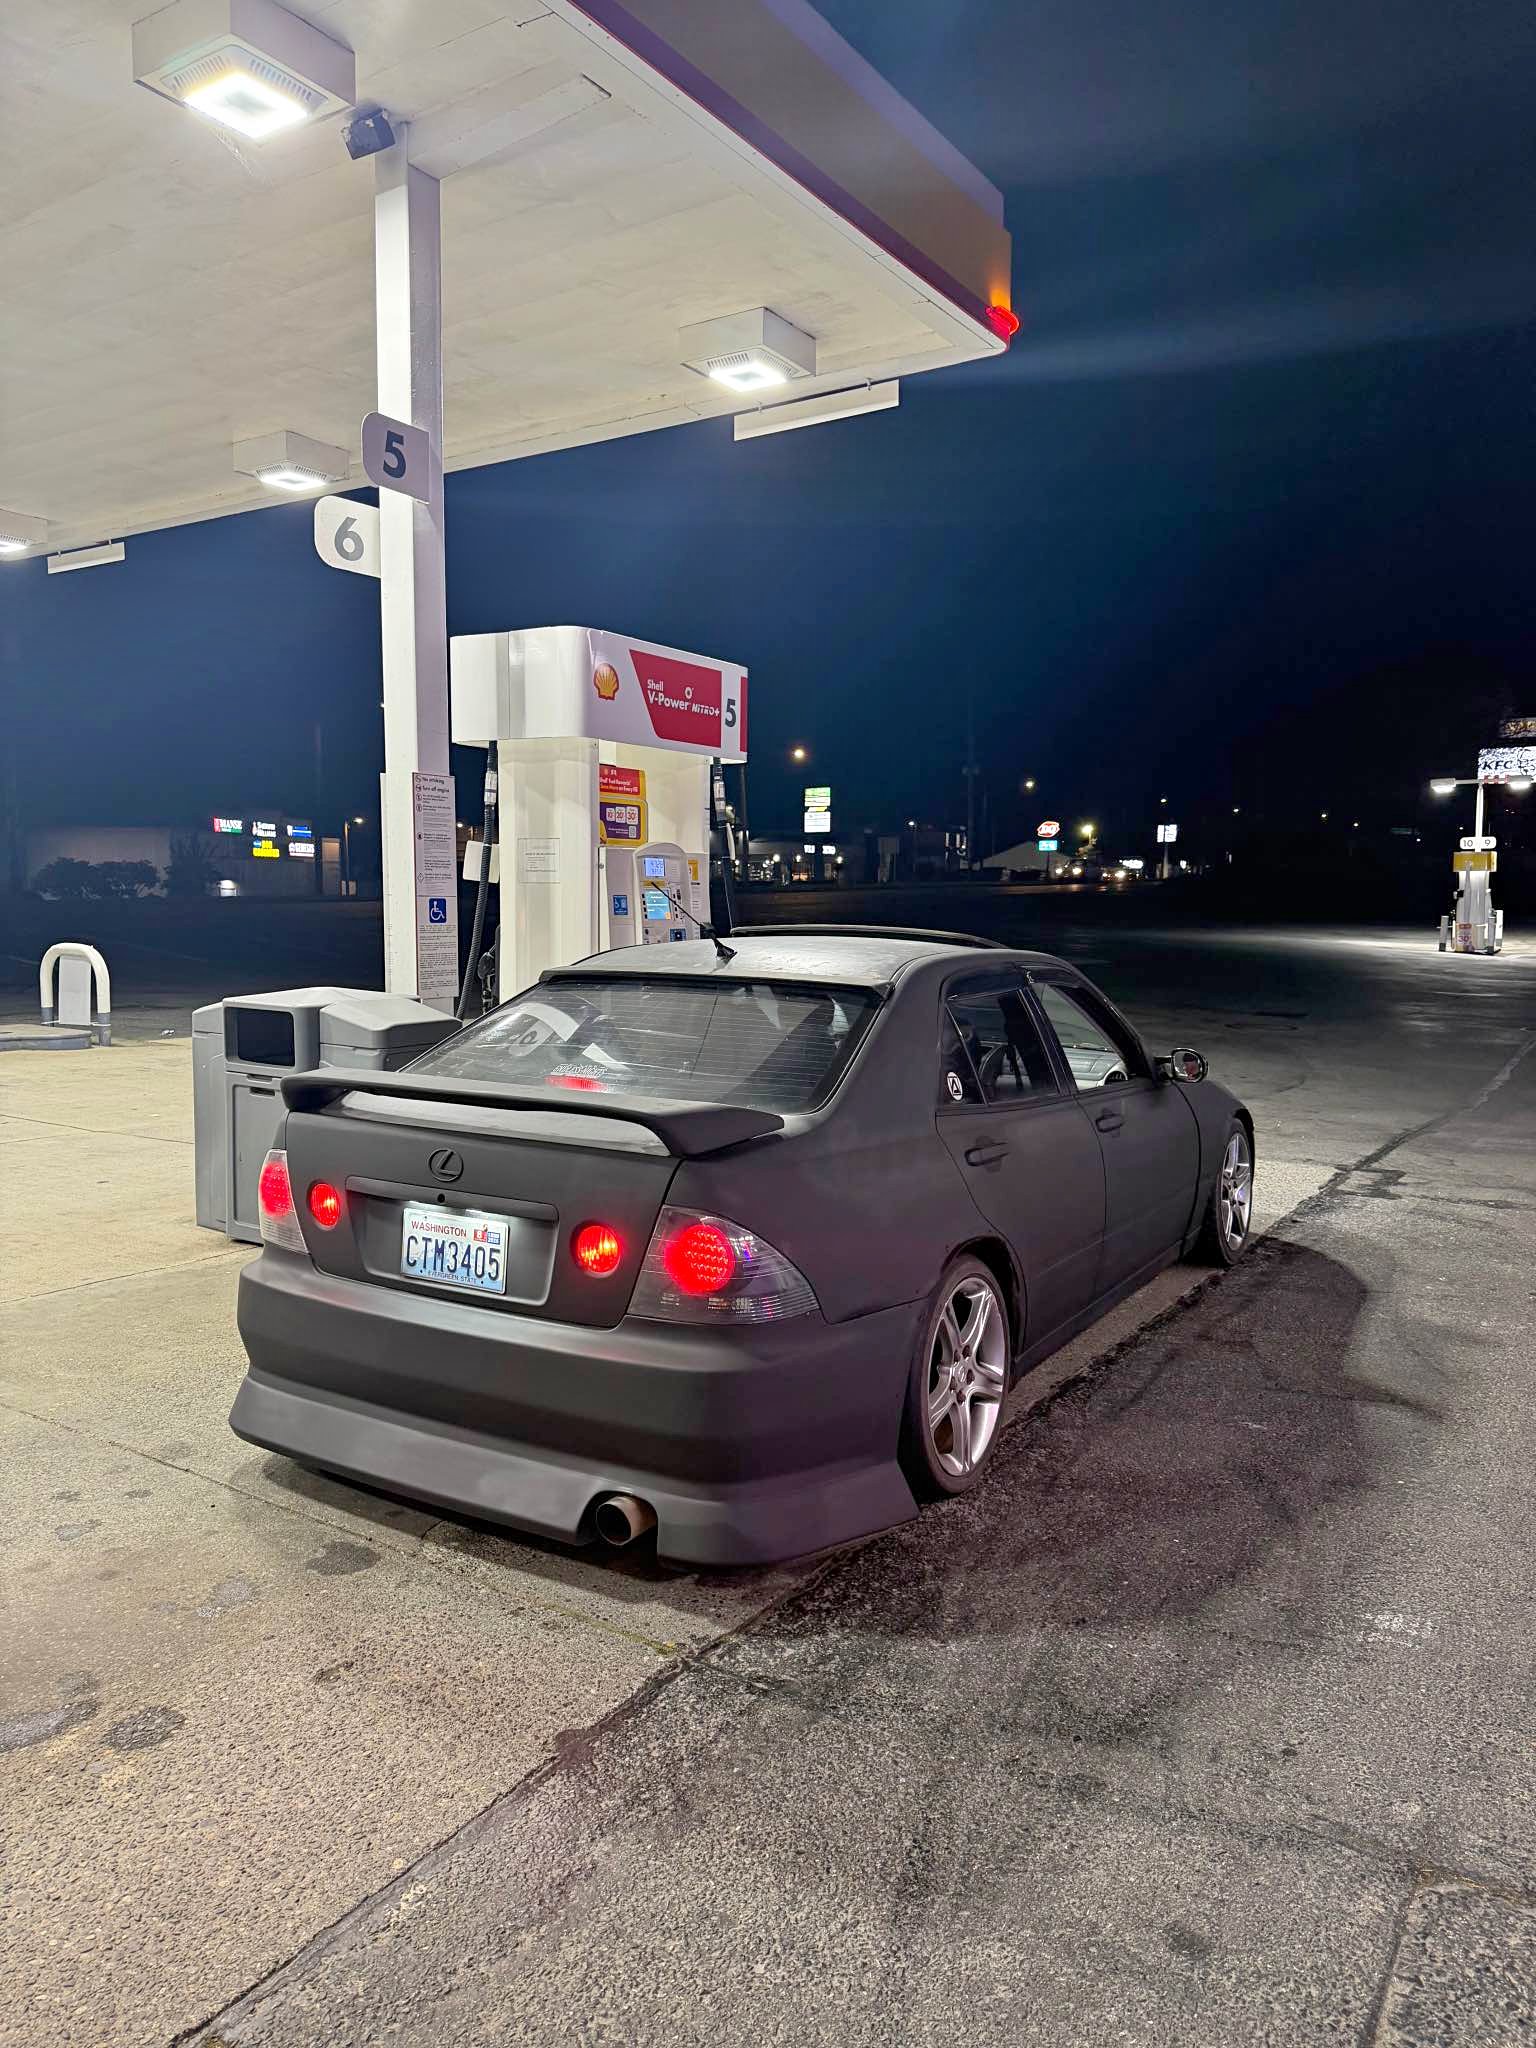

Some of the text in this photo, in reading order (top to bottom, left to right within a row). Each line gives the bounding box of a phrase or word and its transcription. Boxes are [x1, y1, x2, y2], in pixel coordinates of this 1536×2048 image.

[382, 430, 407, 478] 5
[334, 516, 365, 562] 6
[647, 679, 664, 692] Shell
[647, 690, 689, 711] V-Power
[724, 698, 737, 728] 5
[1482, 760, 1513, 771] KFC
[1463, 839, 1491, 848] 10 9
[411, 1220, 467, 1238] WASHINGTON
[406, 1235, 501, 1281] CTM3405
